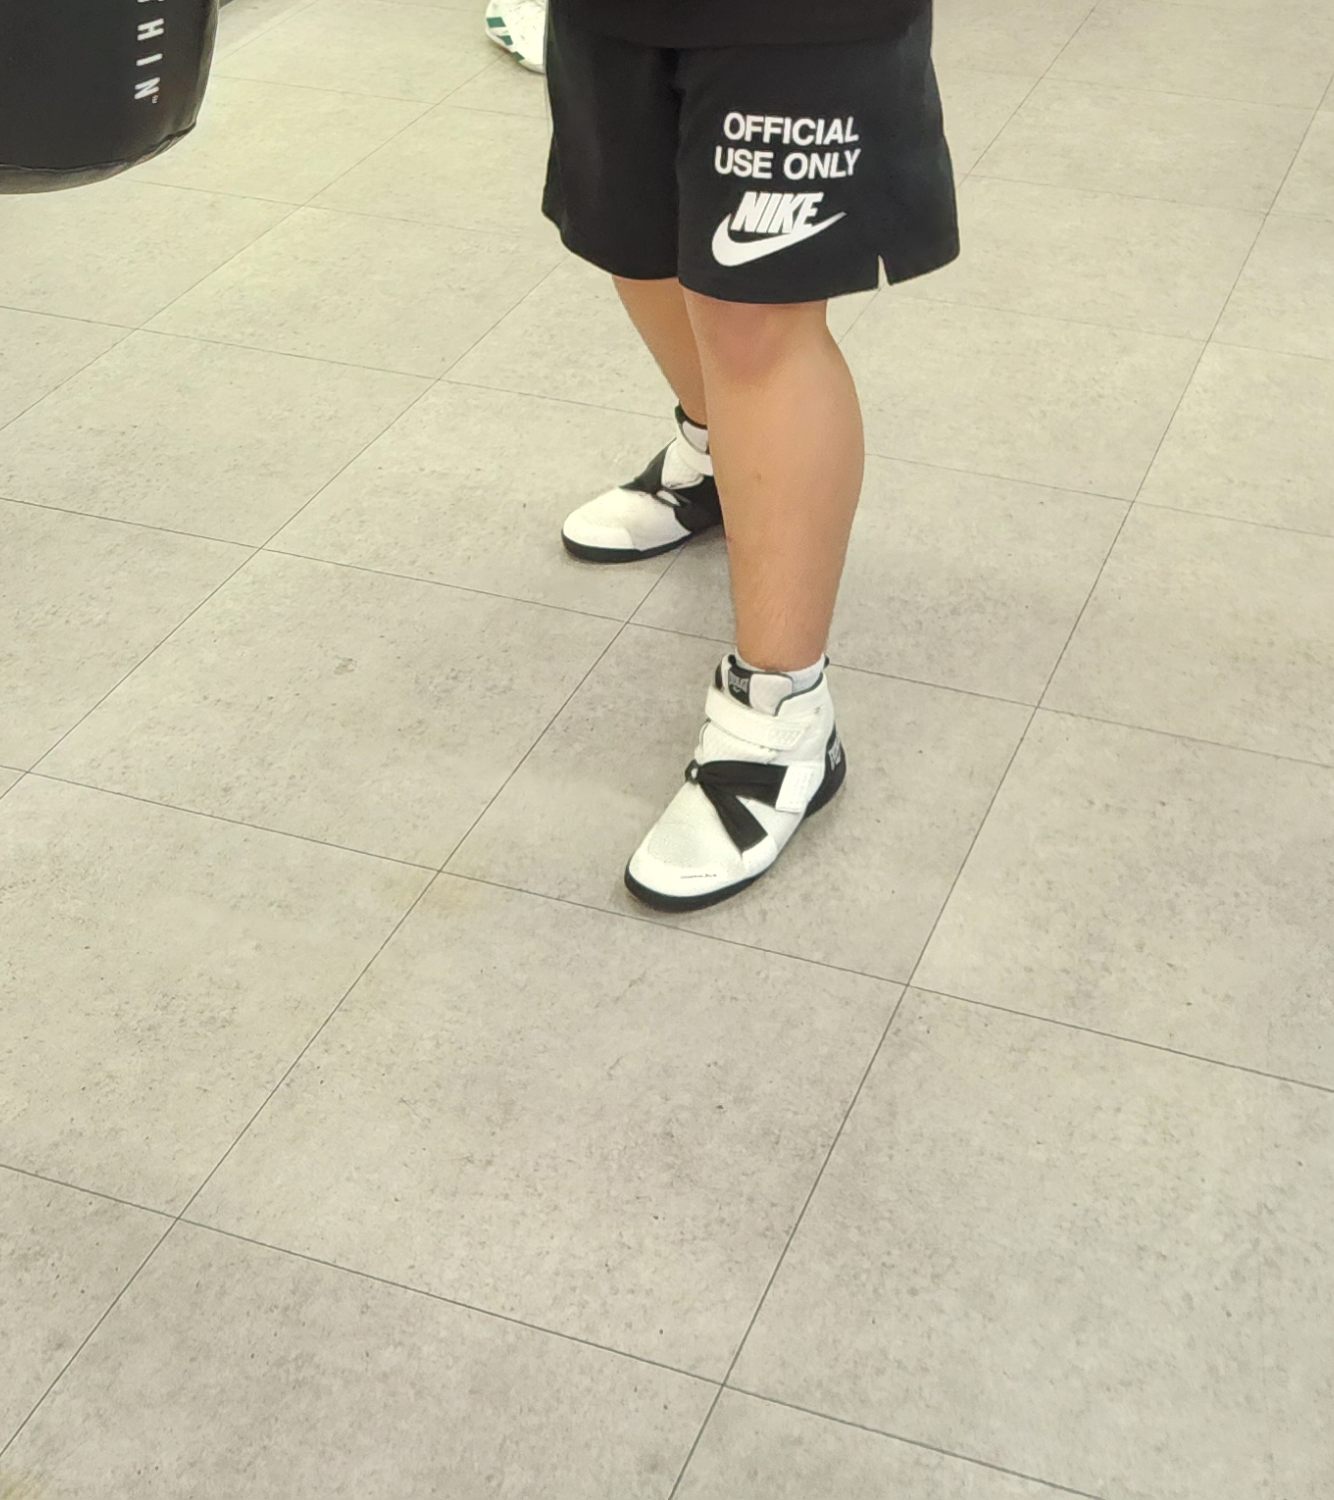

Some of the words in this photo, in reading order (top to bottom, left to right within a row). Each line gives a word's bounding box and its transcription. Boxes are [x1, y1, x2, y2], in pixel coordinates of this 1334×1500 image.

[723, 112, 859, 146] OFFICIAL
[714, 146, 773, 180] USE
[784, 148, 861, 180] ONLY
[731, 191, 824, 234] NIKE
